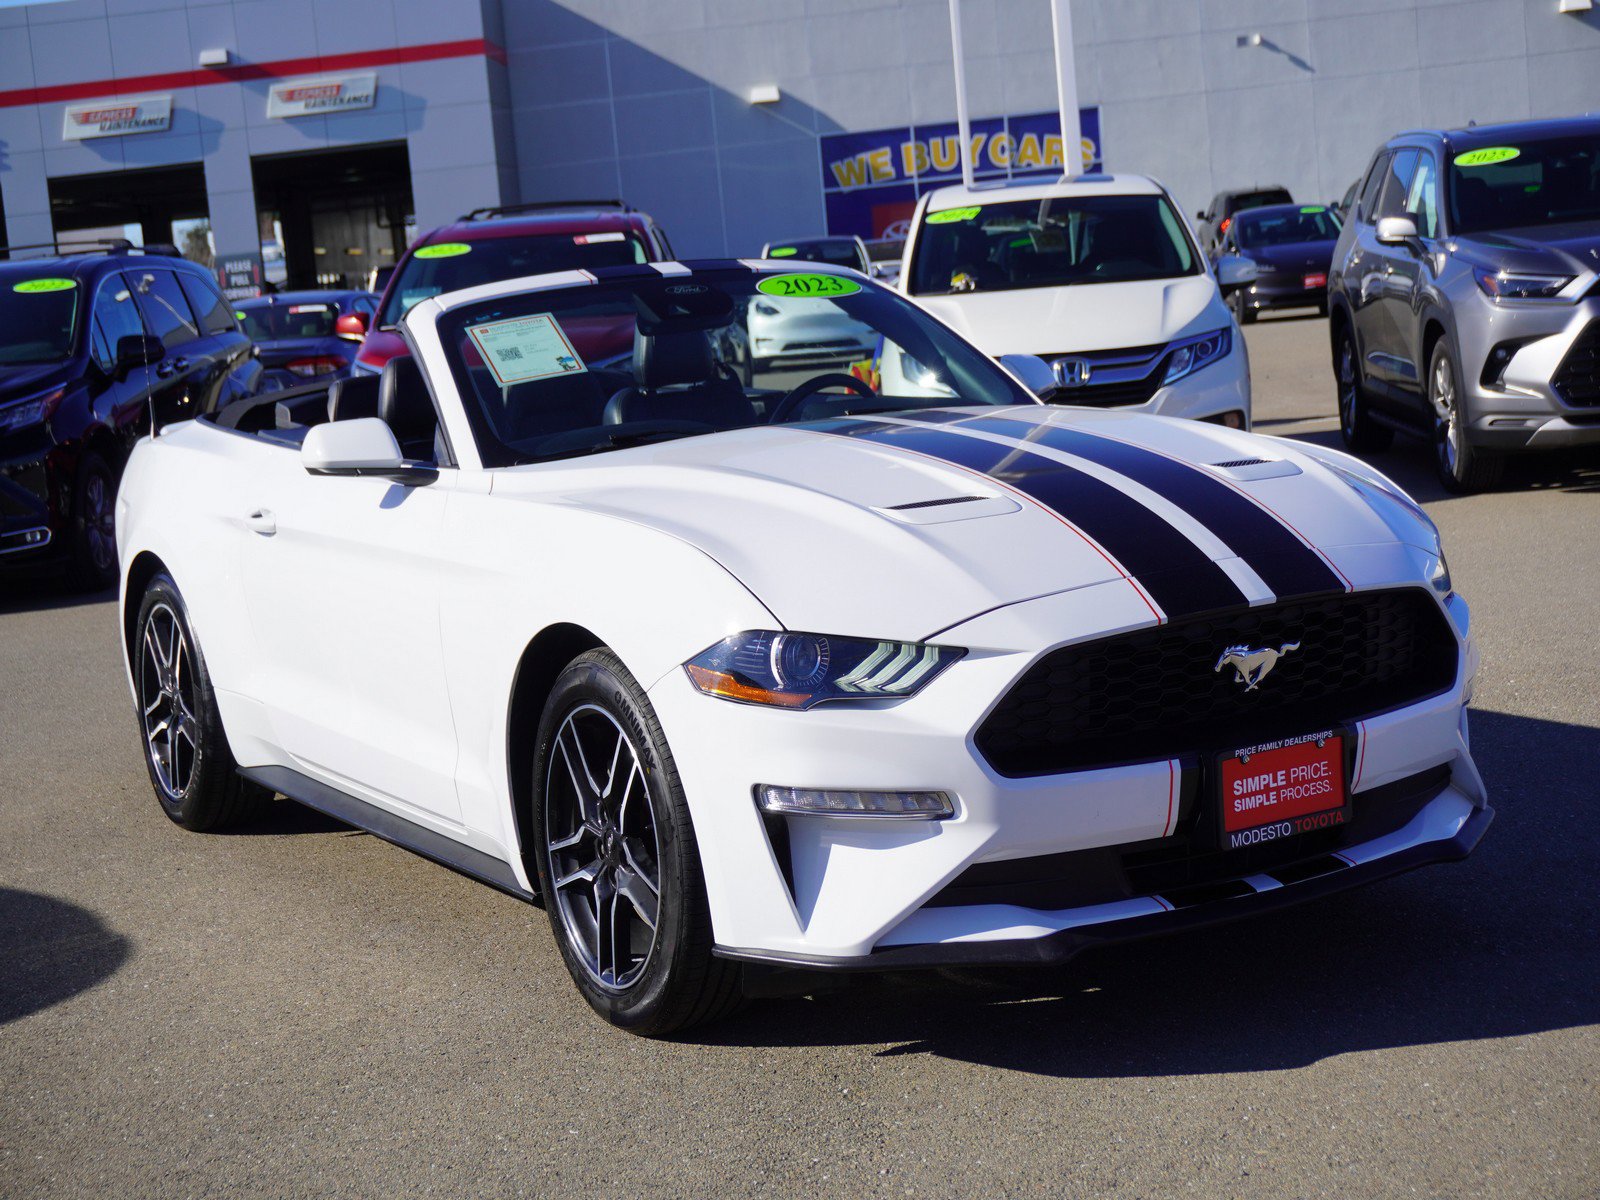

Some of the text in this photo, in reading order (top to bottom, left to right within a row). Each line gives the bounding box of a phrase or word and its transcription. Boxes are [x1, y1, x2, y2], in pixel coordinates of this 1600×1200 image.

[304, 93, 370, 109] MAINTENANCE
[99, 117, 165, 132] MAINTENANCE
[831, 132, 1097, 193] WE BUY CARS
[777, 277, 843, 295] 2023
[1235, 730, 1333, 757] PRICE FAMILY DEALERSHIPS
[1233, 761, 1332, 796] SIMPLE PRICE.
[1234, 780, 1333, 812] SIMPLE PROCESS.
[1231, 811, 1344, 848] MODESTO TOYOTA
